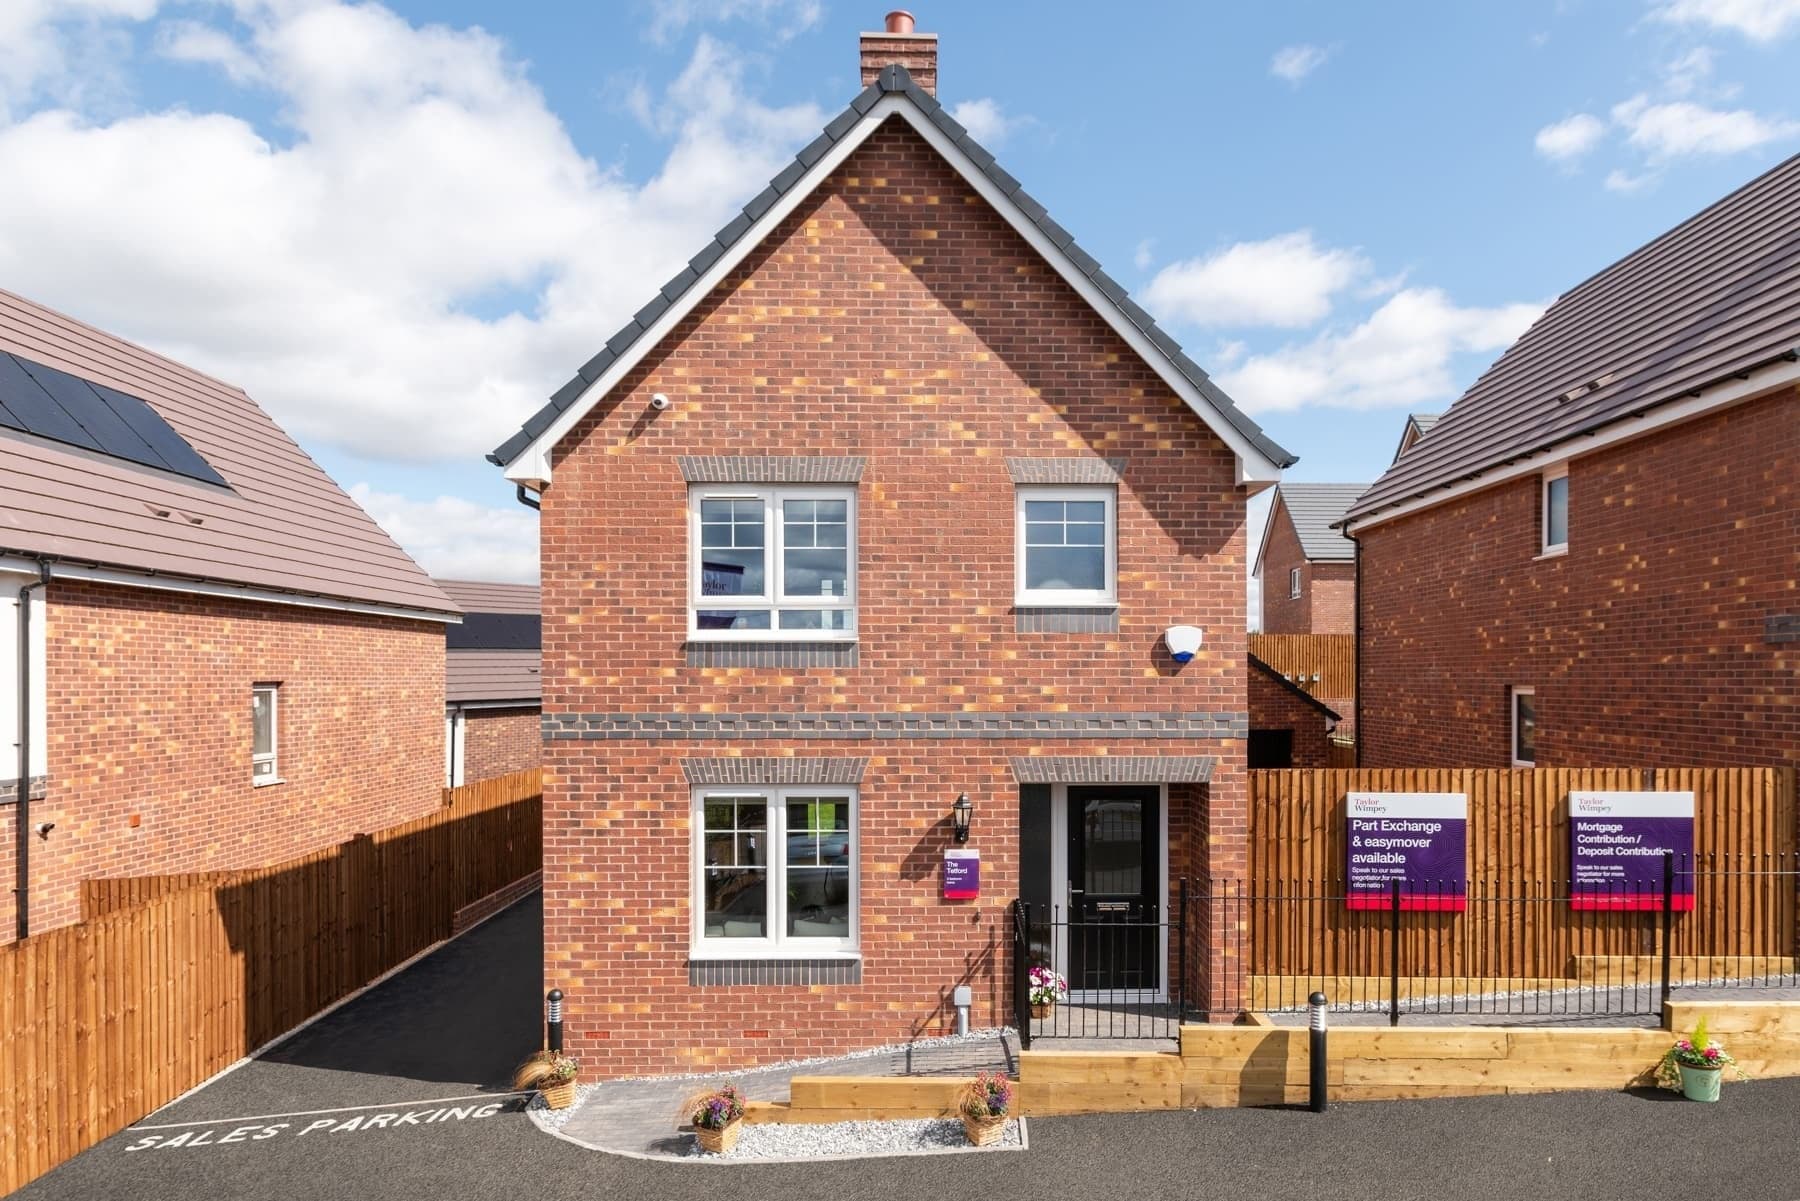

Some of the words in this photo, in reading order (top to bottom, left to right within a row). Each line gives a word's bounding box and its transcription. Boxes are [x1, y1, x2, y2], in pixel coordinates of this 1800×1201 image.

[1354, 797, 1379, 806] Taylor
[1354, 805, 1387, 813] Wimpey
[1578, 804, 1612, 813] Wimpey
[1352, 820, 1378, 831] Part
[1381, 820, 1442, 833] Exchange
[1577, 822, 1623, 833] Mortgage
[1352, 836, 1361, 847] &
[1364, 838, 1432, 849] easymover
[1577, 834, 1636, 844] Contribution
[1577, 846, 1614, 857] Deposit
[1352, 852, 1406, 863] available
[125, 1122, 290, 1152] SALES
[299, 1103, 503, 1137] PARKING
